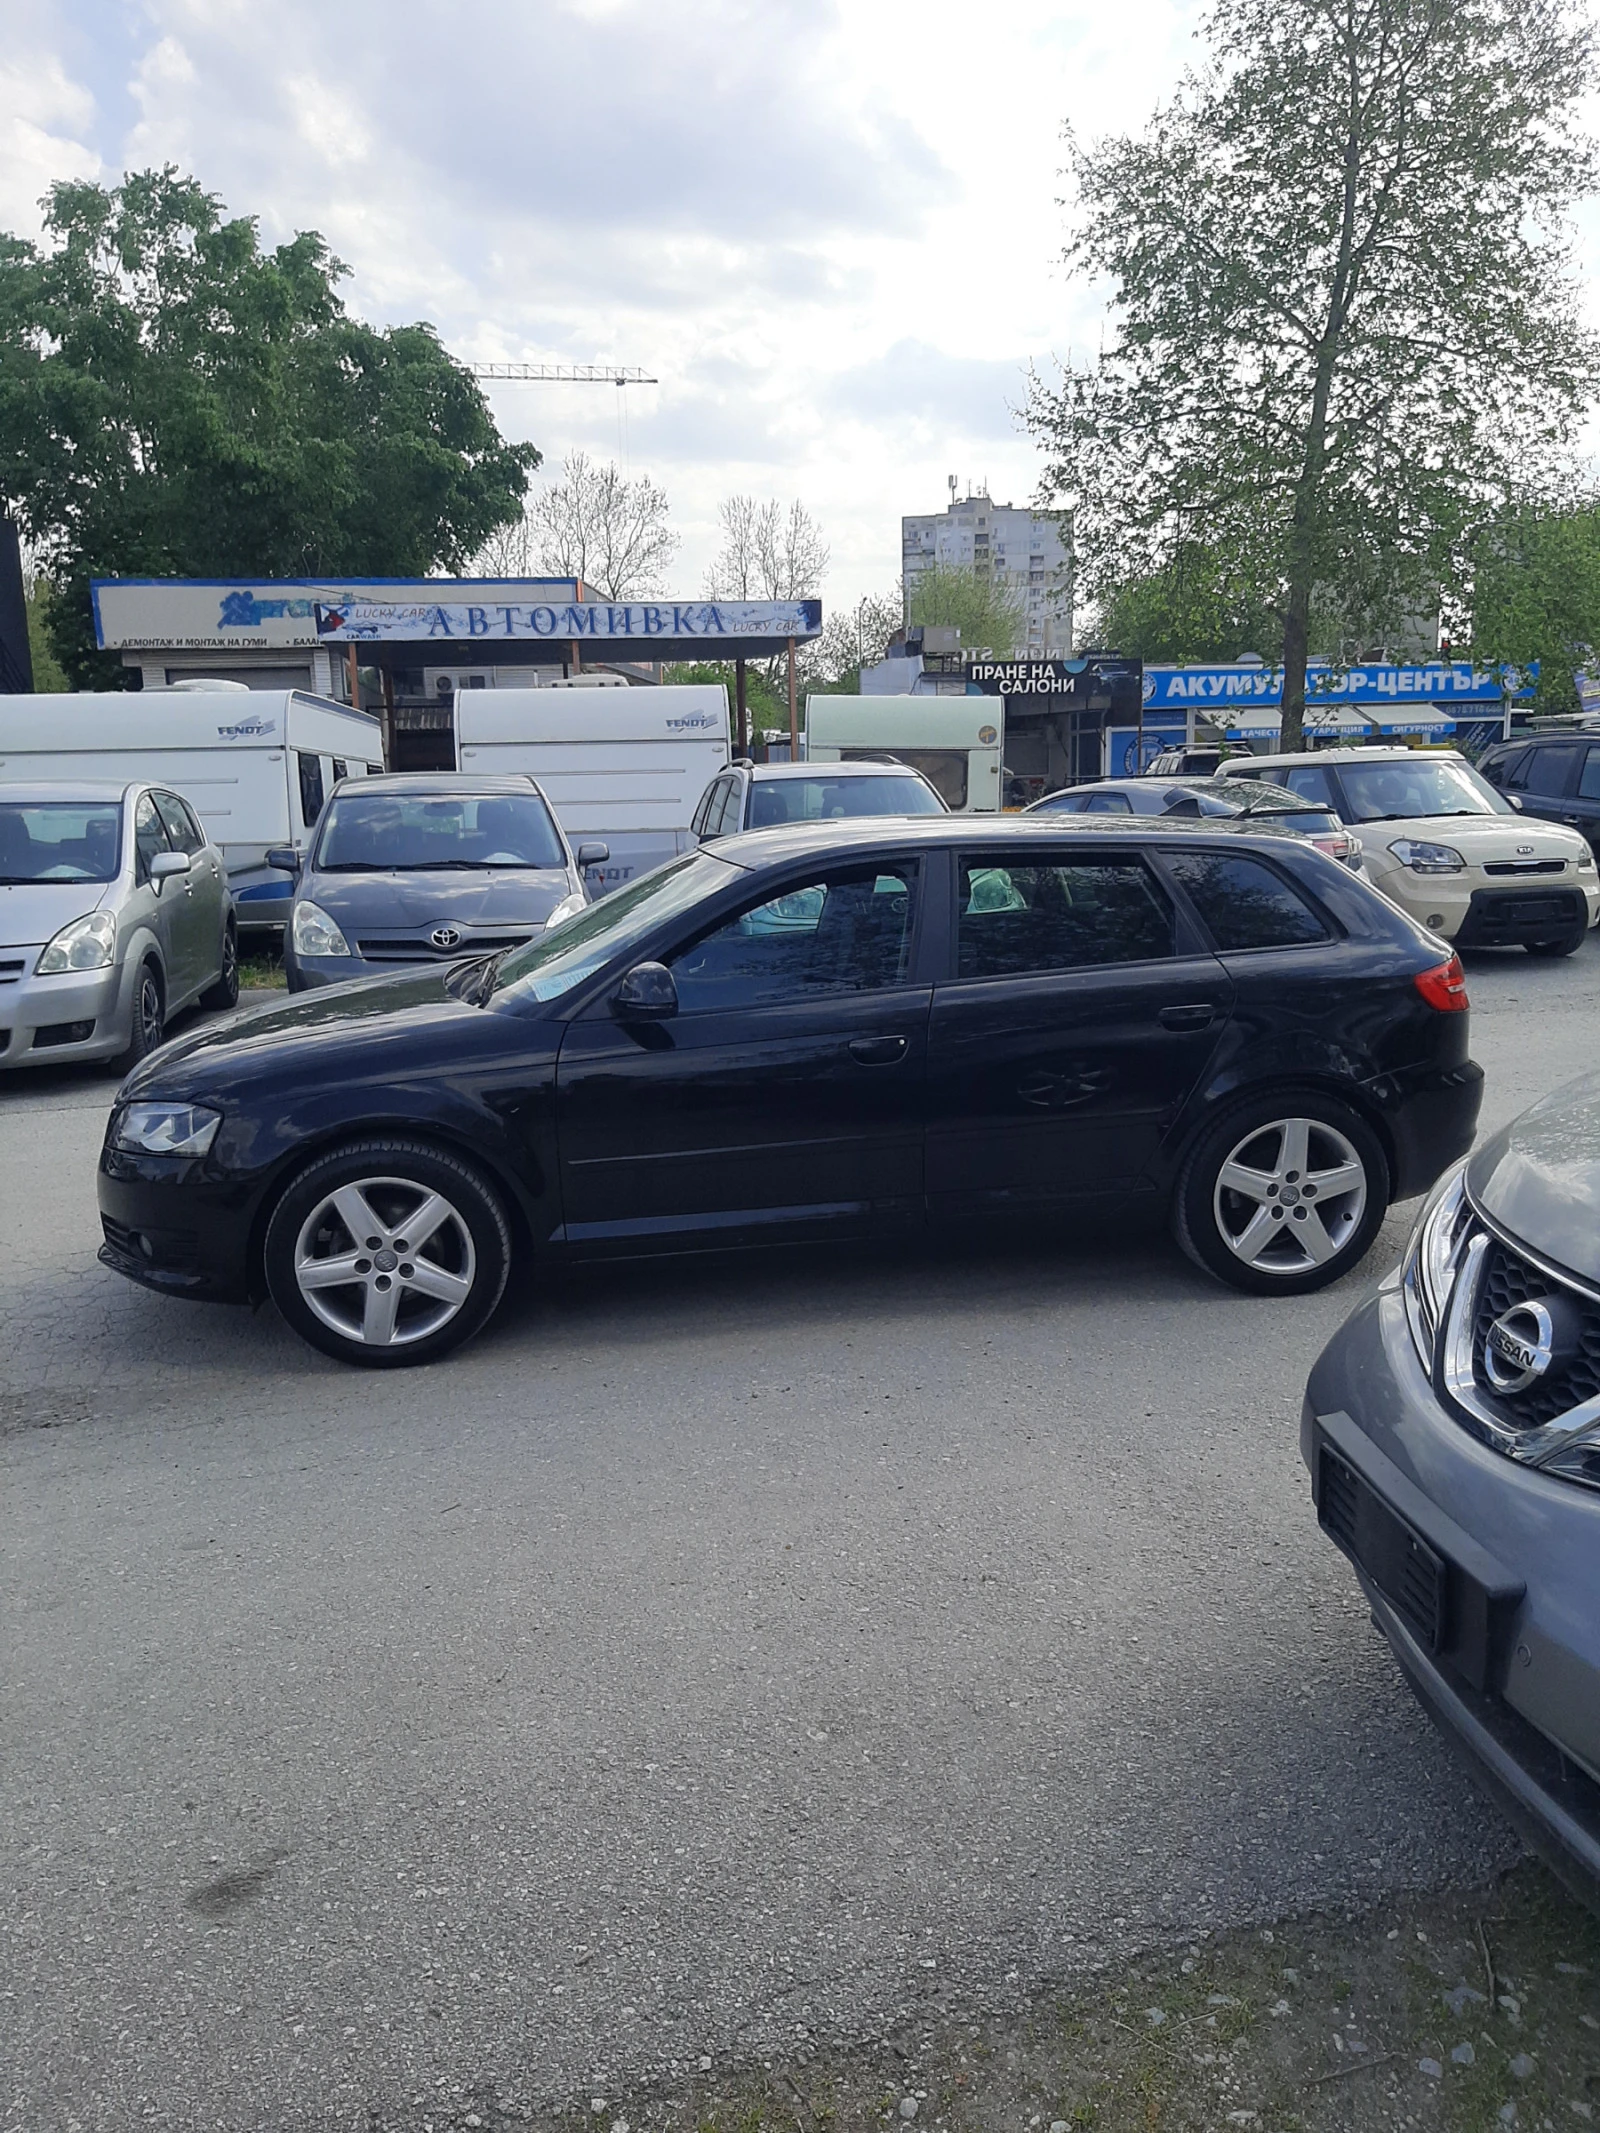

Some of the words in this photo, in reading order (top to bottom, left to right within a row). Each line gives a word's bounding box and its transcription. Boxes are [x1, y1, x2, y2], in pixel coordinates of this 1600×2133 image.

[355, 607, 396, 619] LUCKY
[402, 608, 425, 618] CAR
[427, 605, 727, 637] АВТОМИВКА
[733, 621, 771, 633] LUCKY
[775, 621, 799, 632] CAR
[121, 639, 174, 648] ДЕМОНТАЖ
[176, 639, 183, 647] И
[185, 639, 226, 647] МОНТАЖ
[227, 638, 240, 647] НА
[242, 638, 268, 647] ГУМИ
[971, 664, 1028, 681] ПРАНЕ
[1031, 664, 1056, 679] НА
[998, 678, 1075, 695] САЛОНИ
[1166, 671, 1490, 698] АКУМУЛТОР-ЦЕНТЪР
[665, 719, 707, 728] FENDT
[1391, 724, 1445, 734] СИГУРНОСТ
[217, 726, 264, 735] FENDT
[1240, 728, 1281, 738] КАЧЕСТ
[586, 866, 634, 880] ENDT
[1489, 1323, 1536, 1367] NISSAN
